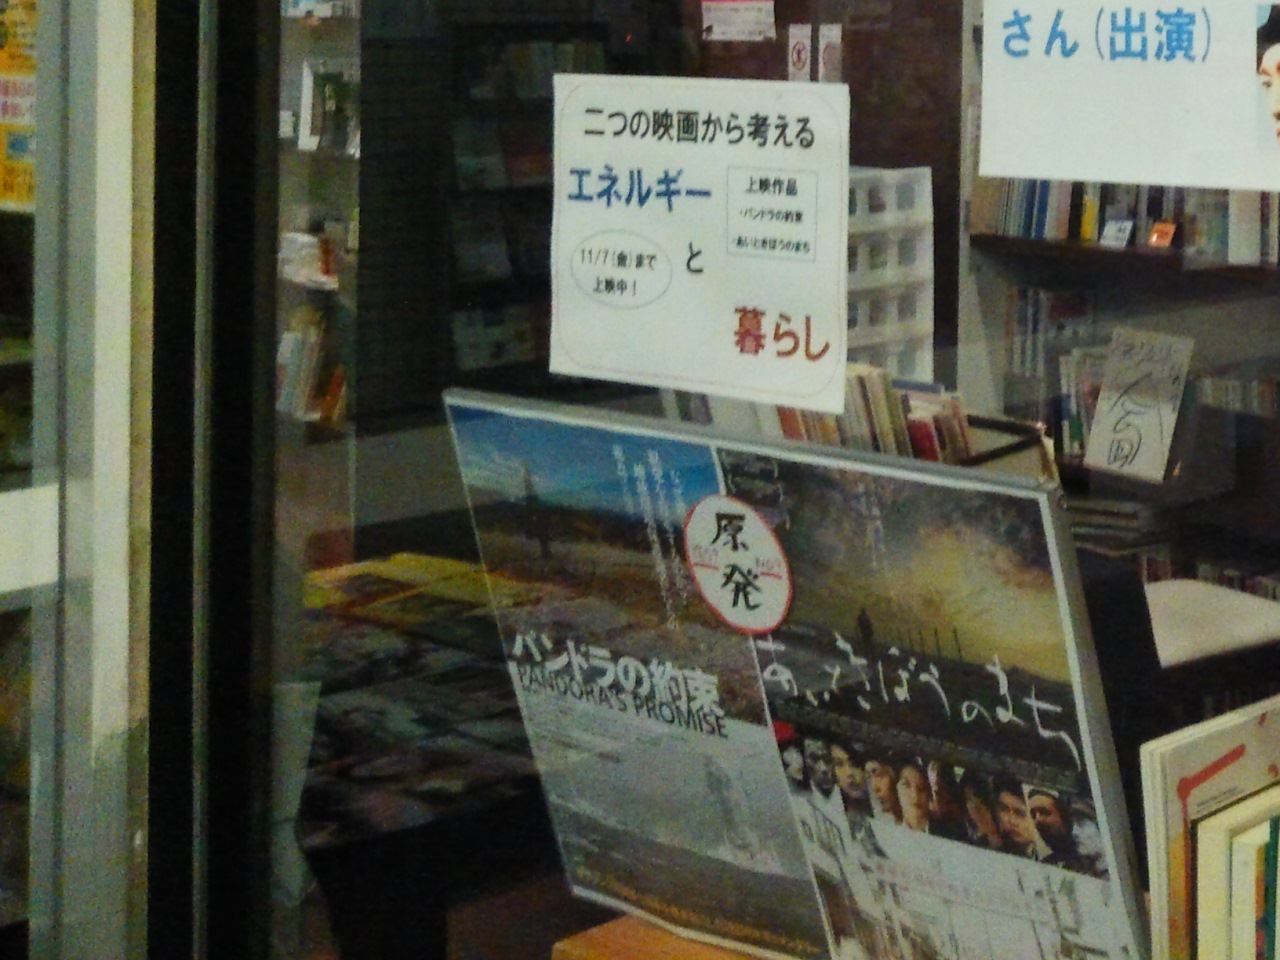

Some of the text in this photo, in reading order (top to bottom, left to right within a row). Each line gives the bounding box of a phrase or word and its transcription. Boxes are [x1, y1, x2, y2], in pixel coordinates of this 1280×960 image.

[1003, 7, 1211, 63] さん(出演)
[584, 108, 815, 149] 二つの映画から考える
[568, 164, 711, 213] エネルギー
[686, 242, 704, 274] と
[735, 306, 830, 362] 暮らし
[710, 512, 763, 611] 原発
